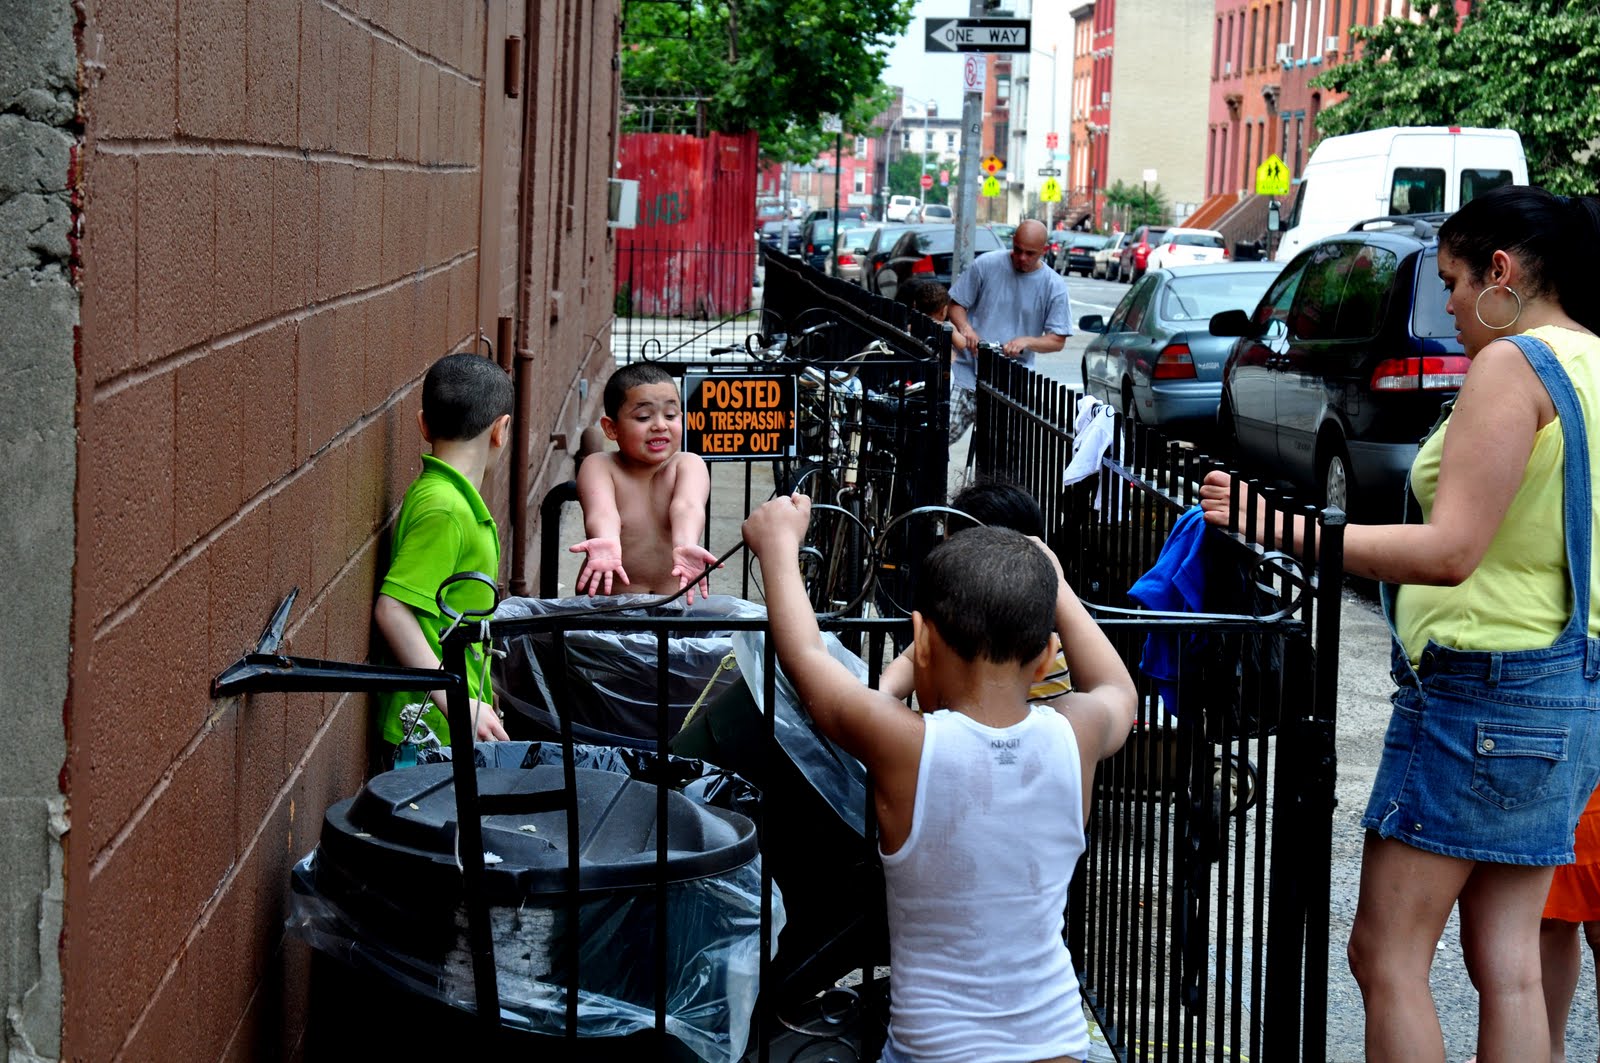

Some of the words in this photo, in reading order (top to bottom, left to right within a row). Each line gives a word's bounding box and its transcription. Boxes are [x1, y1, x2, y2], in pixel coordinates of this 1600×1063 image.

[945, 28, 974, 42] ONE
[989, 29, 1019, 42] WAY
[702, 380, 781, 409] POSTED
[687, 411, 705, 430] NO
[702, 433, 744, 452] KEEP
[750, 432, 780, 452] OUT
